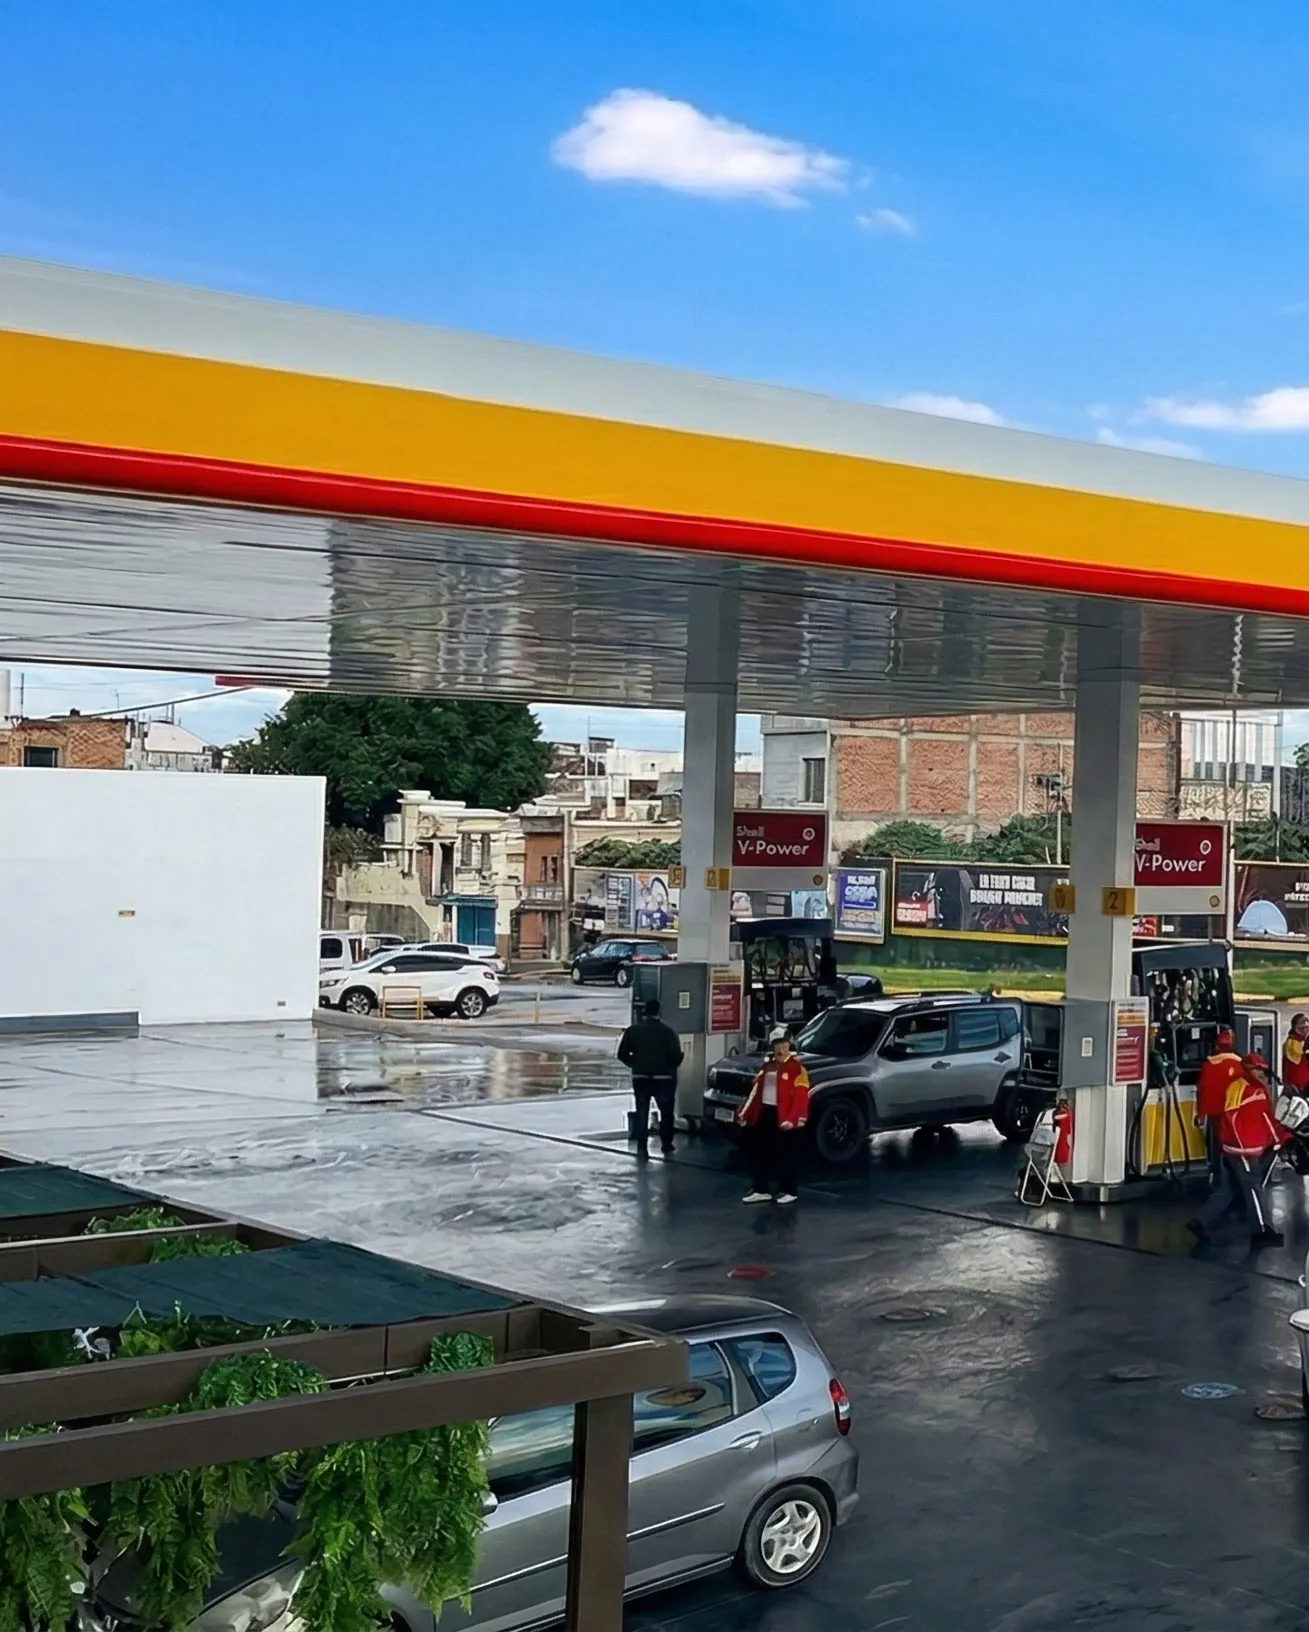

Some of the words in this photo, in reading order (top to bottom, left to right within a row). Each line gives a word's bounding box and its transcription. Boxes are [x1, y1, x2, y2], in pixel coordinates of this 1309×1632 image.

[737, 839, 810, 856] V-Power
[1135, 853, 1206, 873] V-Power
[1108, 890, 1119, 911] 2
